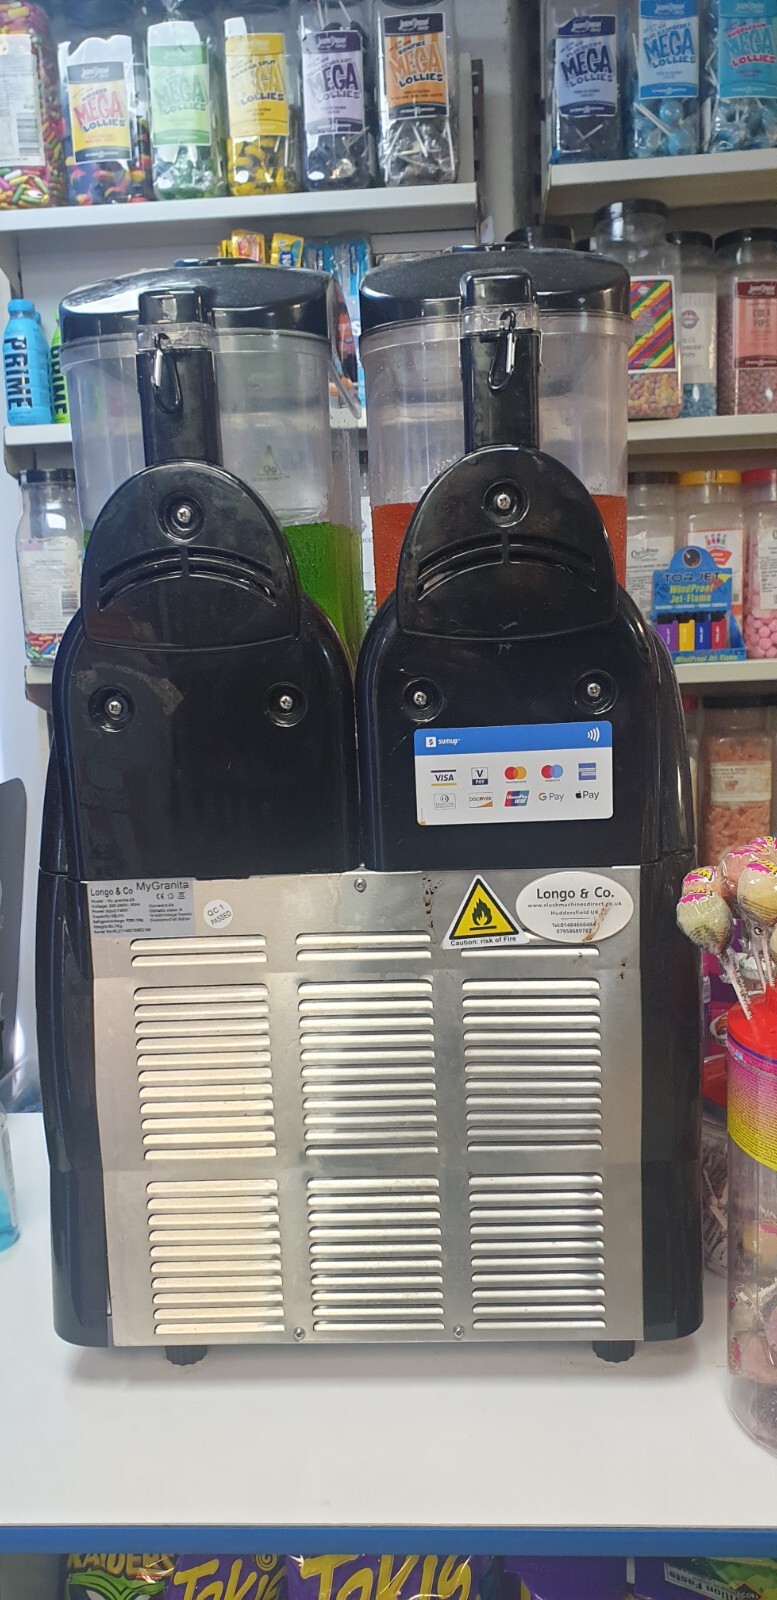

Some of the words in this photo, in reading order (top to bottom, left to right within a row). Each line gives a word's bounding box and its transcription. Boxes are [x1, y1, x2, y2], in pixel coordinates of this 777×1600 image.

[643, 27, 695, 66] MEGA
[725, 27, 773, 62] MEGA
[390, 42, 443, 87] MEGA
[560, 44, 613, 82] MEGA
[652, 55, 696, 69] LOLLIES
[731, 54, 776, 67] LOLLIES
[399, 72, 443, 88] LOLLIES
[570, 73, 613, 88] LOLLIES
[154, 74, 206, 114] MEGA
[241, 92, 284, 106] LOLLIES
[318, 90, 360, 103] LOLLIES
[72, 90, 124, 130] MEGA
[164, 102, 207, 115] LOLLIES
[83, 118, 126, 133] LOLLIES
[4, 337, 33, 411] PRIME
[669, 583, 715, 594] WindProof
[434, 774, 455, 782] VISA
[476, 769, 484, 778] V
[549, 792, 565, 802] Pay
[582, 790, 600, 801] Pay
[90, 888, 114, 898] Longo
[115, 886, 121, 896] &
[122, 886, 134, 895] Co
[136, 880, 190, 893] MyGranita
[536, 888, 576, 902] Longo
[579, 888, 590, 899] &
[594, 886, 615, 898] Co.
[207, 906, 220, 917] QC
[210, 910, 232, 926] PASSED
[450, 938, 479, 947] Caution:
